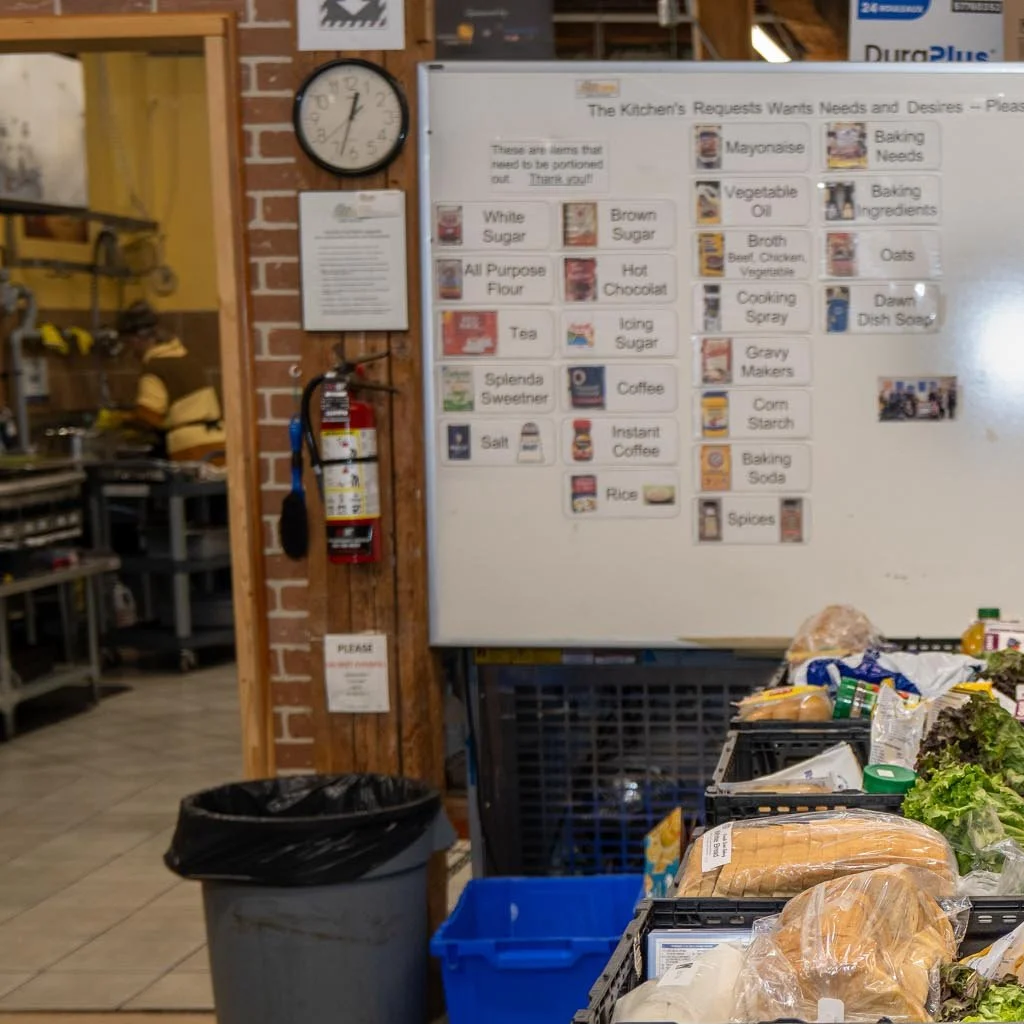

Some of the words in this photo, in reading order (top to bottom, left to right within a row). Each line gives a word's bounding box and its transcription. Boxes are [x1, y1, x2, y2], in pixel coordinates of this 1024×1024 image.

[861, 2, 877, 13] 24
[864, 44, 989, 62] DuraPlus
[588, 103, 615, 118] The
[620, 102, 686, 117] Kitchen's
[693, 101, 762, 118] Requests
[768, 102, 814, 115] Wants
[819, 101, 867, 115] Needs
[871, 100, 899, 113] and
[907, 101, 963, 113] Desires
[874, 130, 925, 145] Baking
[490, 144, 525, 155] These
[529, 147, 547, 155] are
[582, 145, 603, 155] that
[725, 141, 805, 157] Mayonaise
[876, 149, 924, 162] Needs
[491, 160, 520, 169] need
[522, 160, 533, 169] to
[535, 160, 550, 169] be
[552, 160, 604, 171] portioned
[529, 173, 563, 185] Thank
[724, 185, 799, 201] Vegetable
[871, 184, 922, 200] Baking
[482, 210, 525, 224] White
[610, 208, 657, 222] Brown
[751, 204, 772, 218] Oil
[857, 203, 938, 220] Ingredients
[483, 229, 526, 245] Sugar
[612, 227, 655, 243] Sugar
[748, 234, 787, 248] Broth
[880, 248, 915, 262] Oats
[464, 263, 483, 277] All
[485, 263, 547, 281] Purpose
[621, 264, 648, 278] Hot
[740, 266, 794, 279] Vegetable
[486, 282, 524, 296] Flour
[603, 282, 668, 296] Chocolat
[736, 291, 797, 307] Cooking
[874, 294, 916, 307] Dawn
[619, 317, 654, 334] Icing
[745, 310, 789, 327] Spray
[857, 313, 891, 327] Dish
[895, 313, 935, 331] Soap
[510, 326, 538, 341] Tea
[615, 336, 658, 352] Sugar
[745, 345, 790, 362] Gravy
[740, 364, 795, 379] Makers
[484, 373, 544, 388] Splenda
[616, 381, 665, 396] Coffee
[481, 391, 549, 406] Sweetner
[752, 398, 789, 411] Corn
[747, 416, 795, 430] Starch
[611, 425, 660, 440] Instant
[481, 435, 509, 450] Salt
[612, 444, 660, 459] Coffee
[741, 451, 792, 469] Baking
[749, 471, 786, 485] Soda
[606, 487, 638, 501] Rice
[727, 512, 775, 527] Spices
[337, 643, 374, 655] PLEASE
